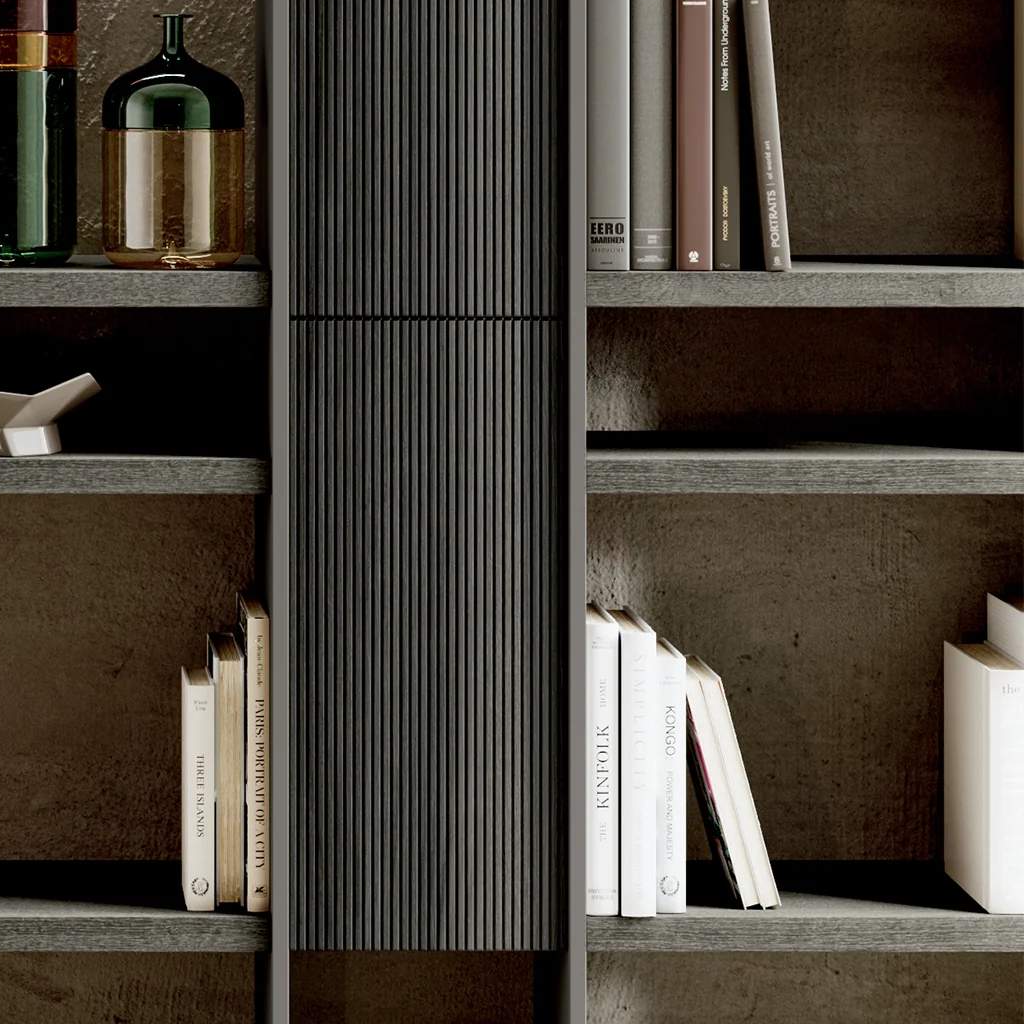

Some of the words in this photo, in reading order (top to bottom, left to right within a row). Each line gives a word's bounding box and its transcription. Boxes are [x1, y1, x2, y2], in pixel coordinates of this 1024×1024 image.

[766, 172, 773, 180] of
[590, 223, 624, 235] EERO
[766, 190, 780, 248] PORTRAITS
[590, 236, 624, 244] SAARINEN
[255, 699, 264, 738] PARIS:
[196, 754, 205, 791] THREE
[255, 742, 264, 806] PORTRAIT
[596, 726, 609, 809] KINFOLK
[196, 793, 205, 838] ISLANDS
[255, 809, 264, 826] OF
[255, 829, 264, 838] A
[255, 841, 264, 870] CITY
